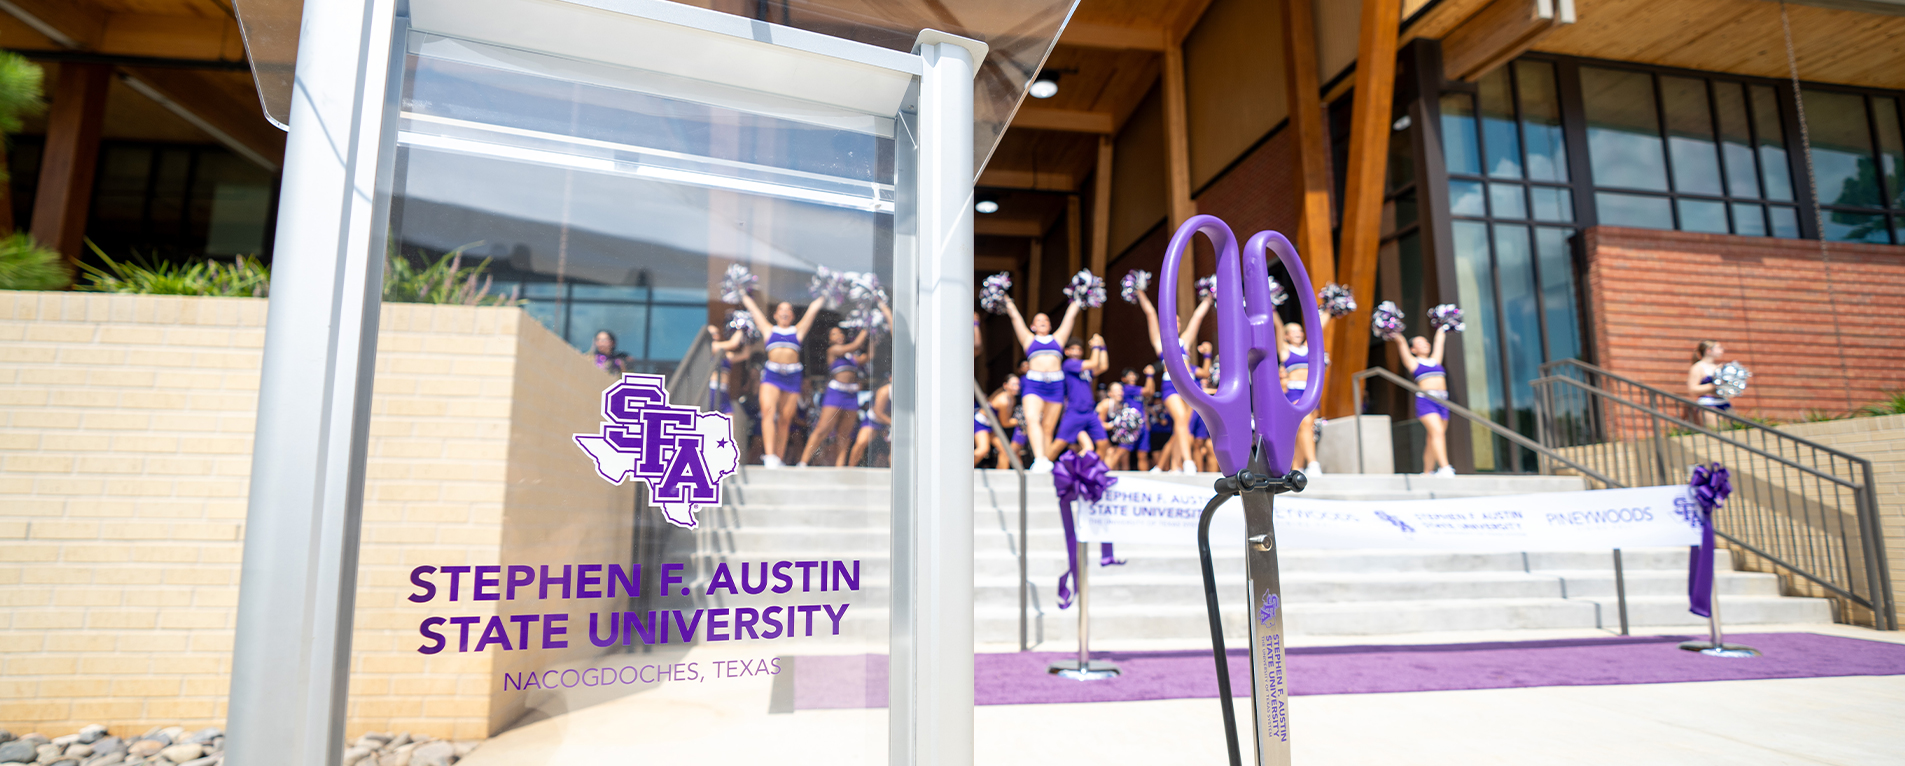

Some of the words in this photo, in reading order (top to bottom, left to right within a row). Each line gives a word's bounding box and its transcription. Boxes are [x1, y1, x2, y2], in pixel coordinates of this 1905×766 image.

[604, 383, 718, 503] SFA
[1088, 504, 1127, 517] STATE
[1133, 506, 1201, 520] UNIVERSIT
[1545, 506, 1654, 526] PINEYWOODS
[408, 562, 642, 603] STEPHEN
[660, 563, 691, 597] F.
[705, 560, 861, 596] AUSTIN
[417, 613, 569, 655] STATE
[588, 603, 851, 648] UNIVERSITY
[1266, 635, 1275, 668] STATE
[1273, 634, 1283, 685] STEPHEN
[503, 661, 705, 692] NACOGDOCHES,
[712, 657, 782, 679] TEXAS
[1277, 688, 1284, 697] F.
[1268, 670, 1280, 738] UNIVERSITY
[1278, 700, 1288, 742] AUSTIN
